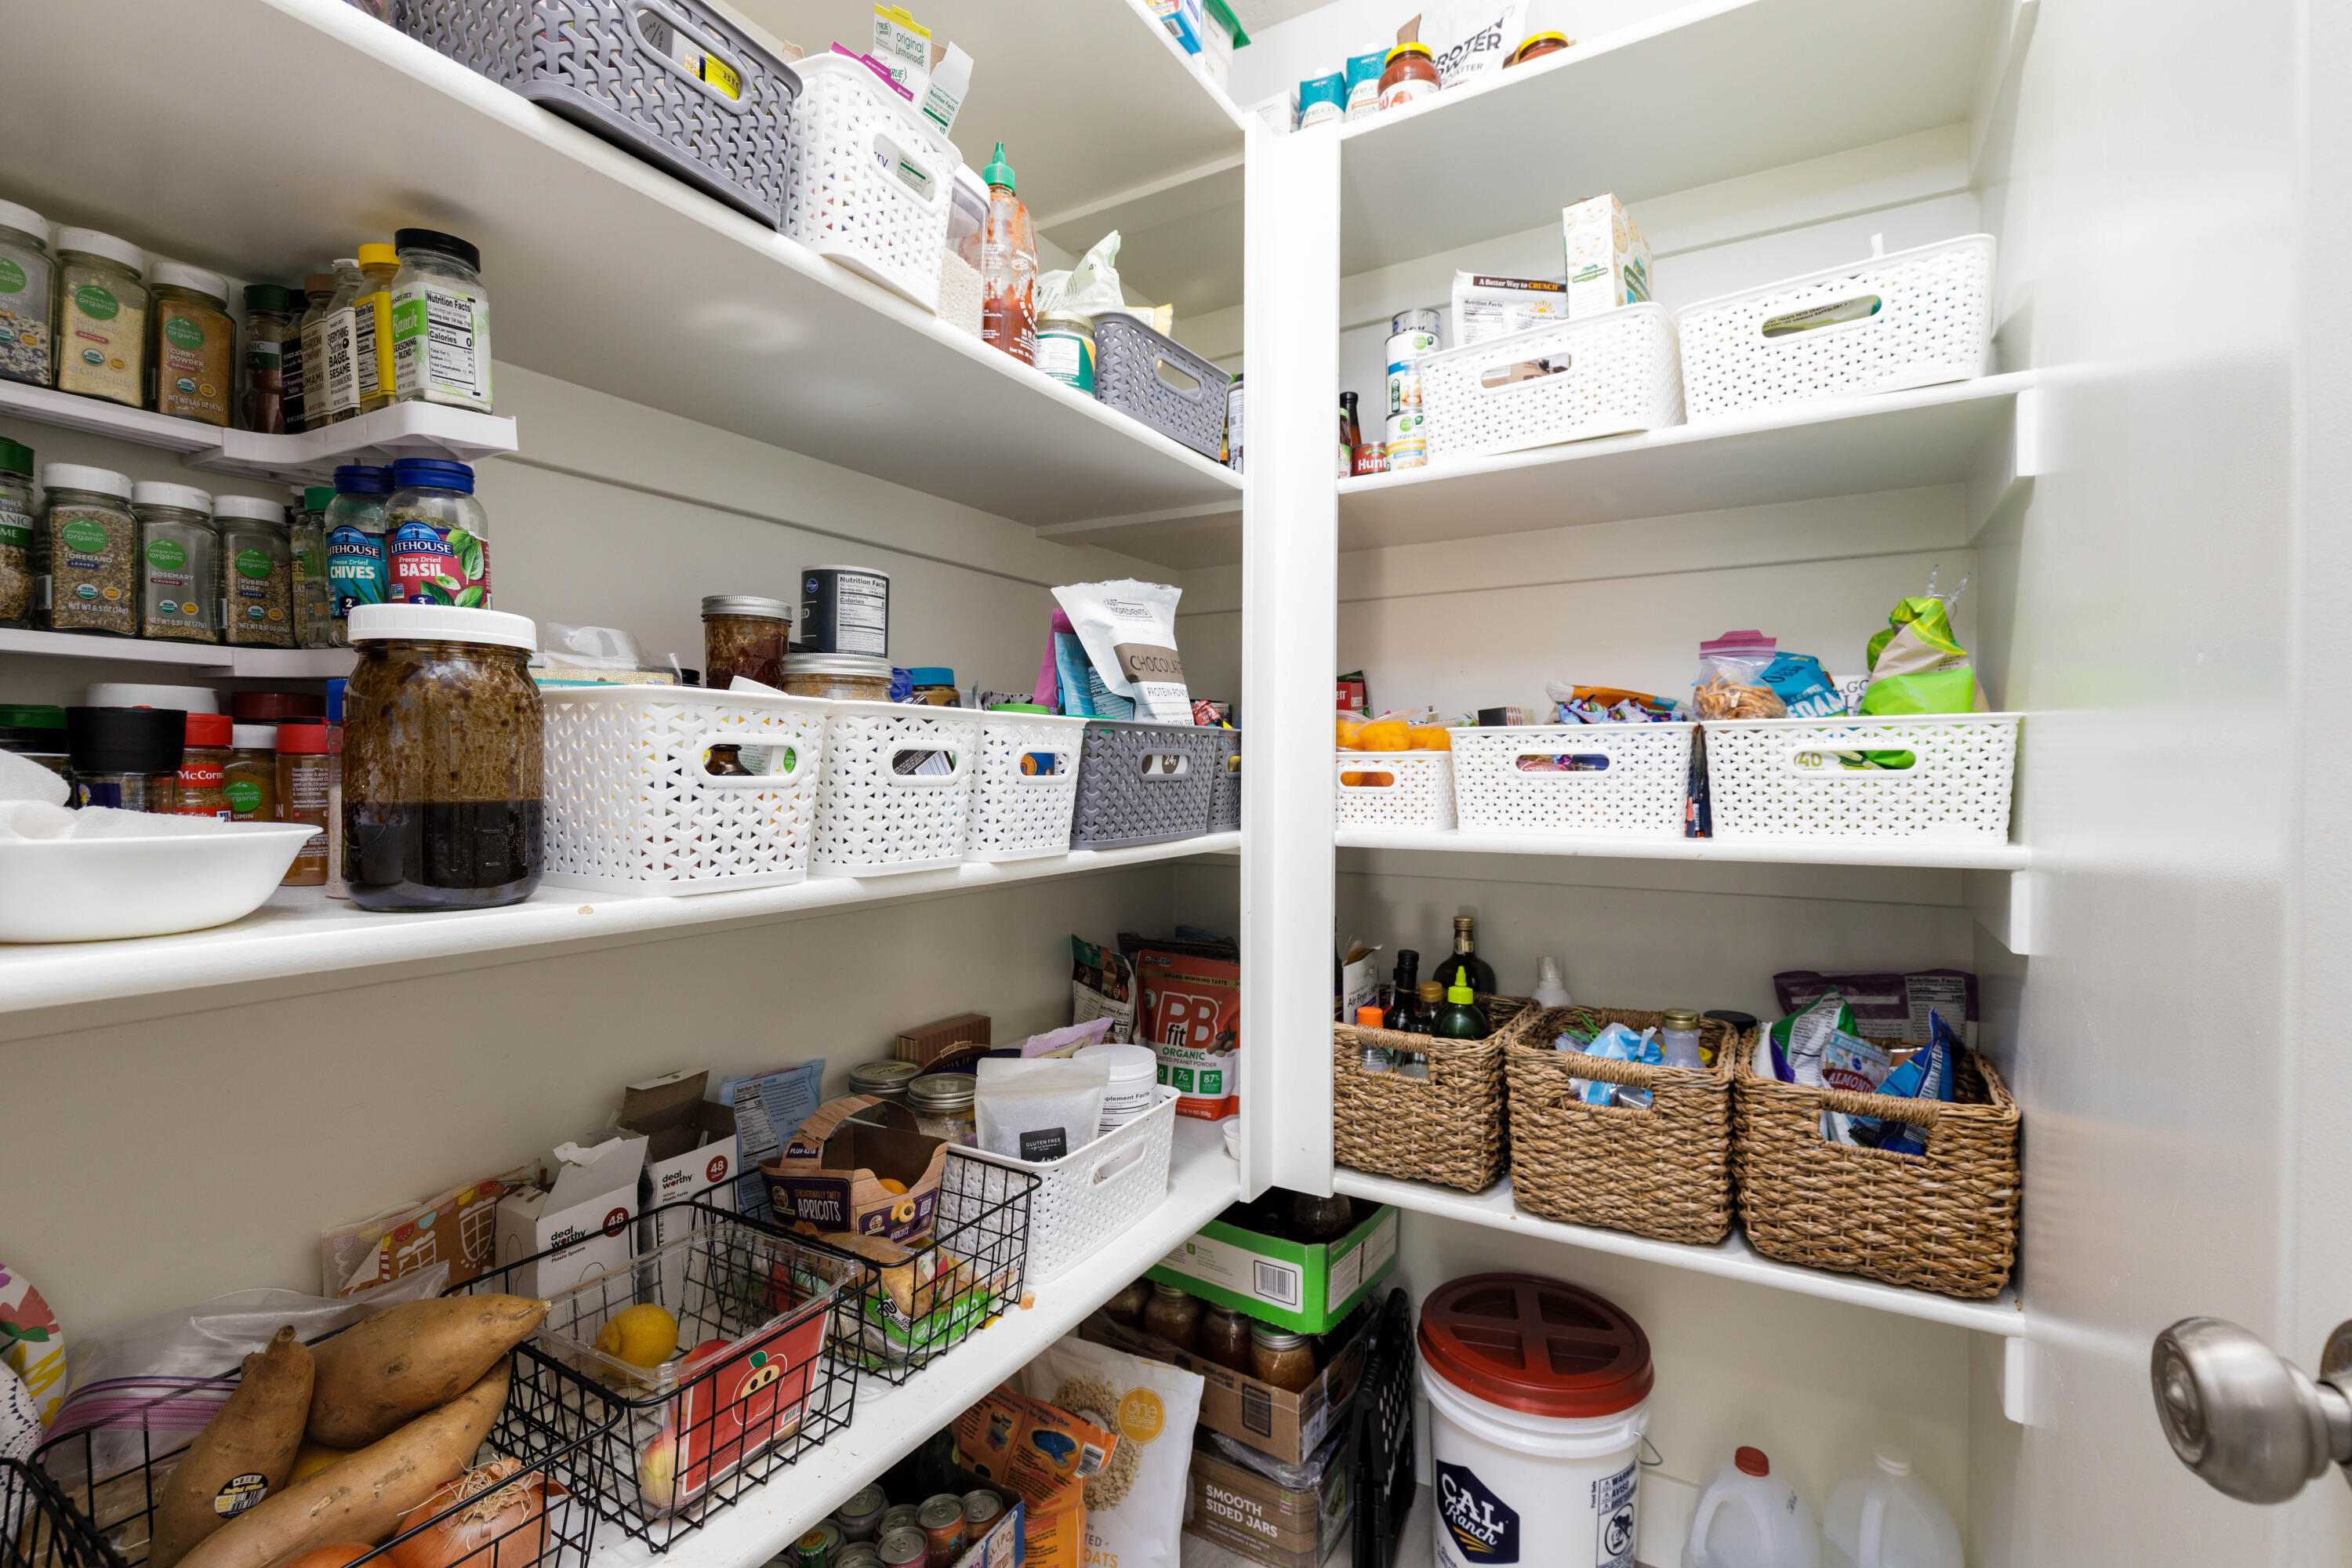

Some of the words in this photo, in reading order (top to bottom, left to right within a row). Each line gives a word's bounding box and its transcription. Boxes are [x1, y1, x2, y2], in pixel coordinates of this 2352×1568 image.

[896, 32, 924, 53] original
[895, 44, 924, 67] Lemonade
[1528, 281, 1558, 290] CRUNCH
[79, 297, 116, 313] organic
[427, 292, 452, 308] Nutrition
[455, 299, 470, 313] Facts
[393, 307, 417, 337] Ranch
[168, 330, 201, 342] organic
[328, 325, 349, 344] EVERYTHING
[430, 331, 457, 344] Calories
[466, 338, 472, 347] 0
[393, 337, 416, 353] SEASONING
[169, 347, 197, 359] CURRY
[328, 350, 350, 368] BAGEL
[398, 350, 412, 360] BLEND
[169, 354, 205, 367] POWDER
[329, 362, 351, 380] SESAME
[0, 514, 30, 527] ANIC
[67, 532, 104, 544] organic
[328, 543, 379, 557] LITEHOUSE
[391, 540, 452, 554] LITEHOUSE
[69, 553, 113, 563] OREGANO
[149, 552, 184, 563] organic
[239, 561, 269, 570] organic
[330, 565, 376, 579] CHIVES
[399, 563, 445, 577] BASIL
[151, 571, 194, 581] ROSEMARY
[241, 579, 270, 587] RUBBED
[840, 576, 870, 586] Nutrition
[1147, 687, 1173, 698] PROTEIN
[1164, 755, 1177, 766] 24g
[1798, 752, 1823, 768] 40
[1163, 972, 1210, 983] AWARD-WINNING
[1156, 991, 1219, 1049] PB
[1166, 1024, 1186, 1047] fit
[1162, 1047, 1206, 1061] ORGANIC
[1178, 1069, 1189, 1081] 7G
[1135, 1091, 1150, 1099] Facts
[710, 1160, 724, 1173] 48
[662, 1170, 682, 1183] deal
[662, 1174, 693, 1189] worthy
[662, 1194, 677, 1203] Plastic
[797, 1197, 841, 1222] APRICOTS
[608, 1212, 625, 1228] 48
[550, 1225, 574, 1241] deal
[551, 1229, 586, 1249] worthy
[551, 1254, 568, 1263] Plastic
[568, 1246, 586, 1258] Spoons
[1206, 1484, 1262, 1517] SMOOTH
[1279, 1488, 1294, 1503] 12
[1442, 1473, 1504, 1534] CAL
[1206, 1498, 1243, 1523] SIDED
[1245, 1515, 1278, 1538] JARS
[1445, 1498, 1498, 1545] Ranch
[1084, 1548, 1119, 1568] OATS
